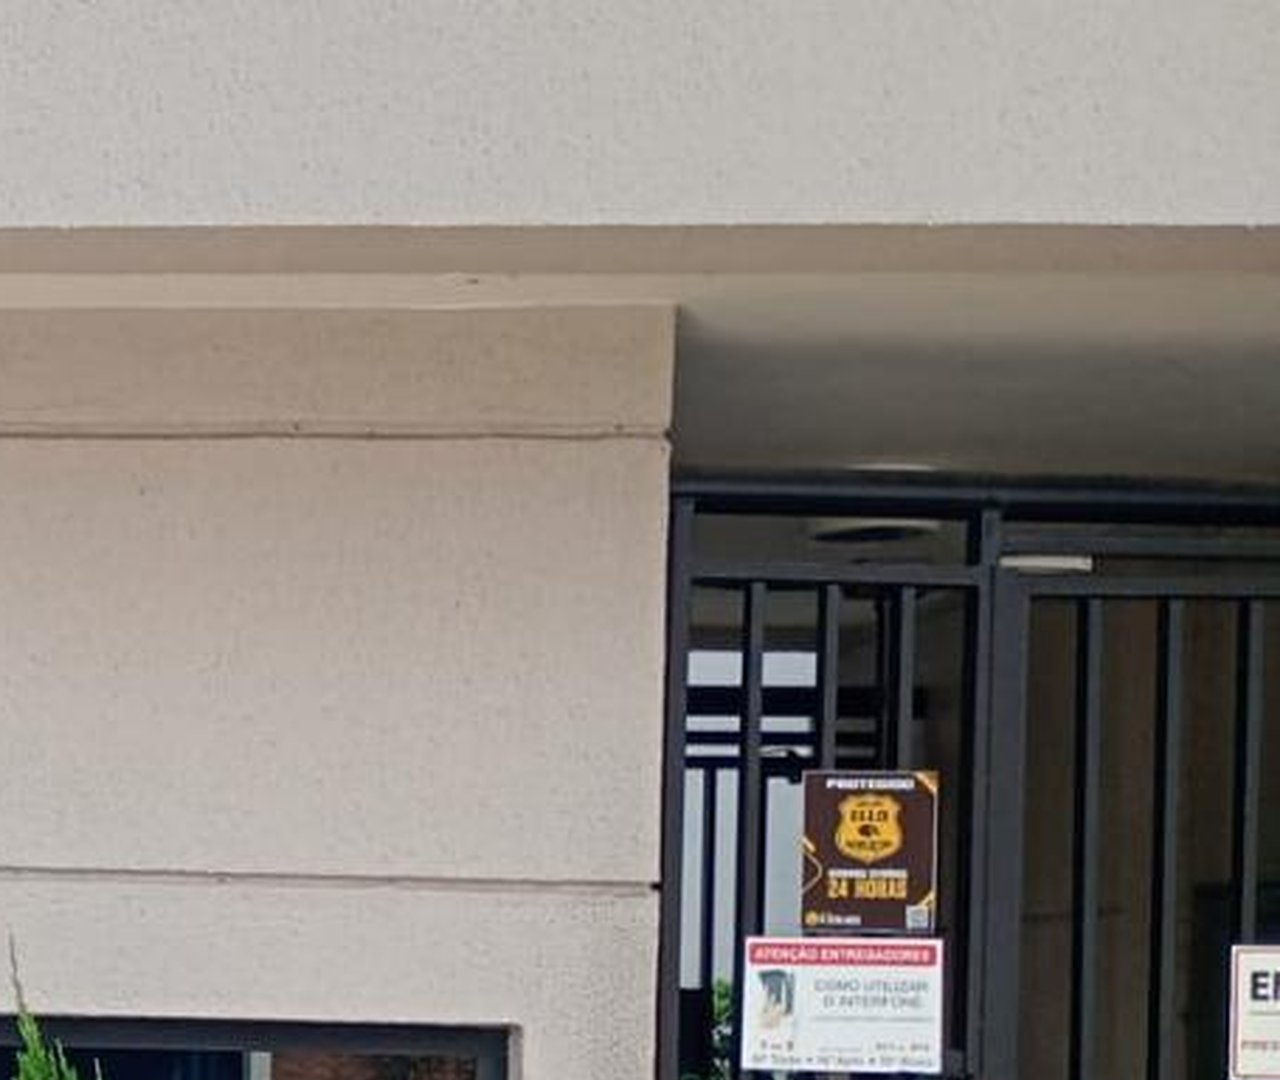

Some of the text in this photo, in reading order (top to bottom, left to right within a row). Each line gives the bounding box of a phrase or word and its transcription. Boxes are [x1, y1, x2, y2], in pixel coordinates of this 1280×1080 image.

[828, 879, 848, 899] 24
[753, 945, 818, 963] ATENÇÃO
[814, 979, 861, 993] COMO
